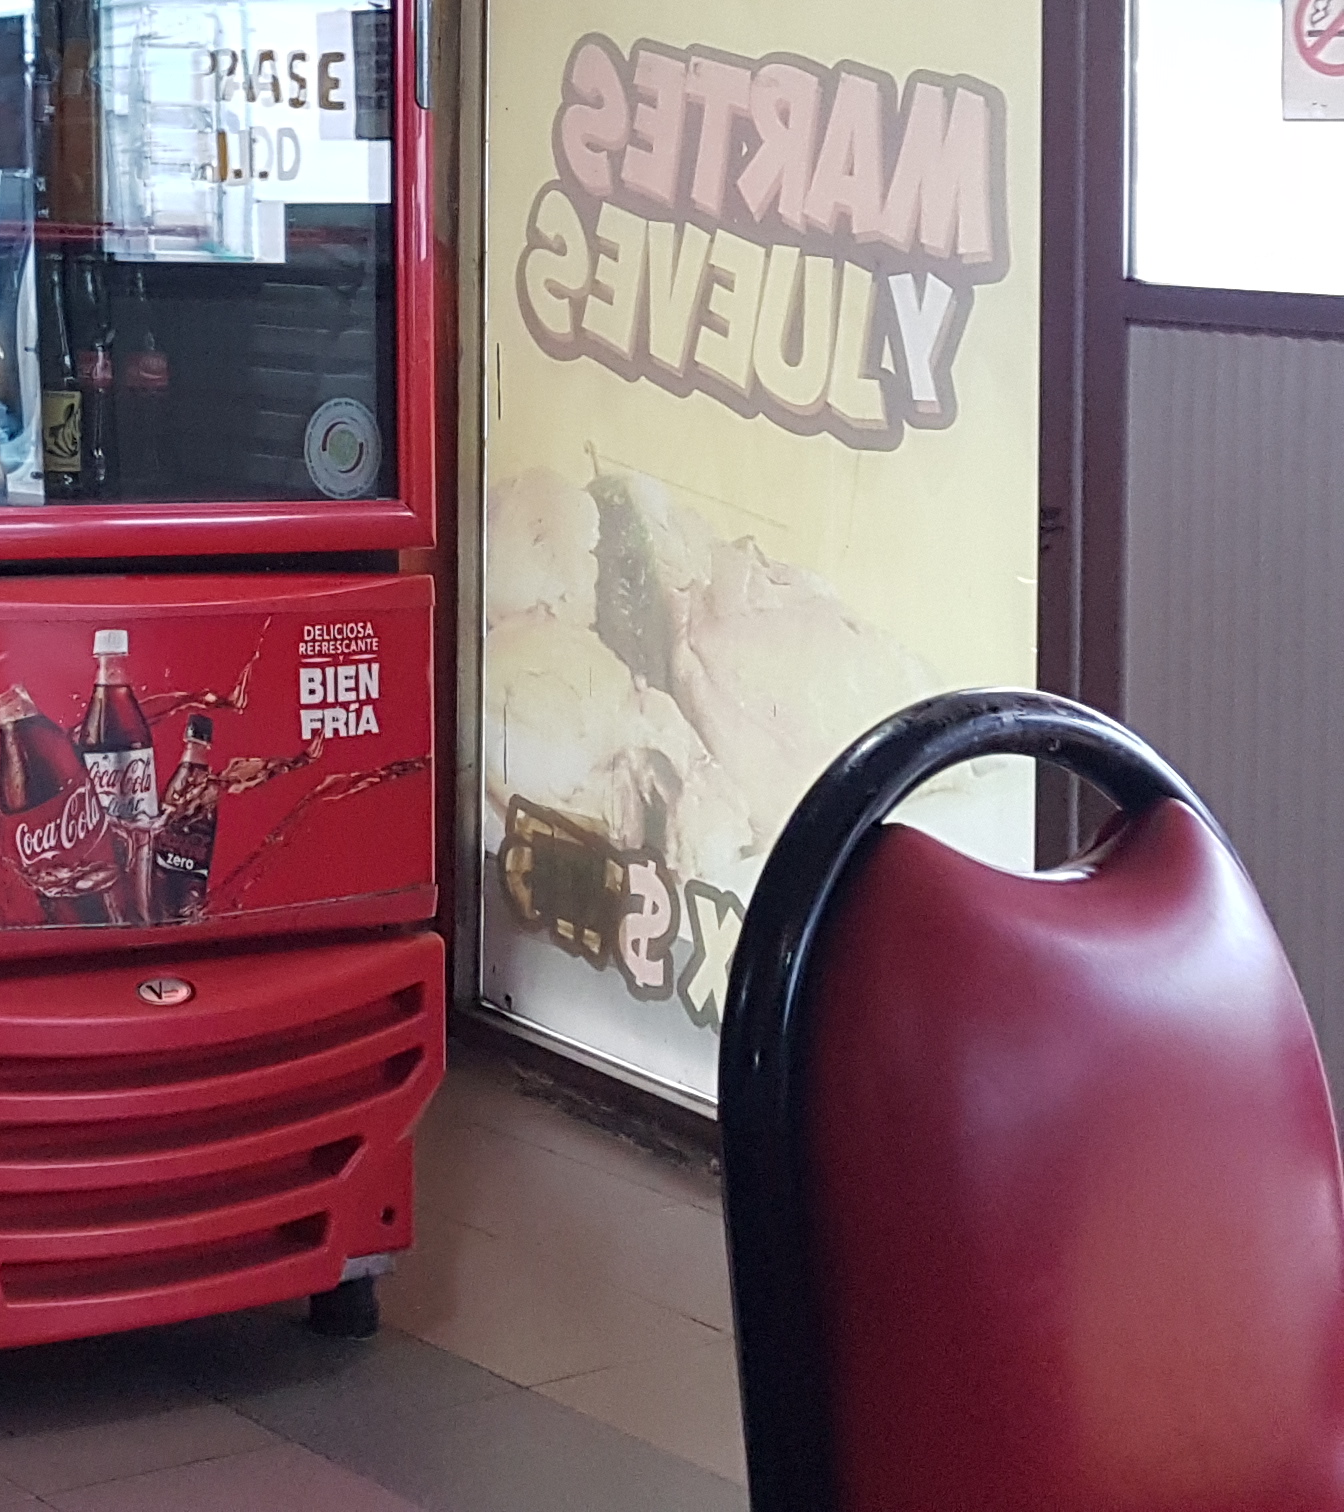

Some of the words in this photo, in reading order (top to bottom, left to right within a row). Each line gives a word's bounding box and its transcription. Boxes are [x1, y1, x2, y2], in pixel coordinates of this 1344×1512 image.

[303, 621, 374, 641] DELICIOSA
[298, 637, 379, 656] REFRESCANTE
[299, 662, 380, 705] BIEN
[15, 784, 102, 866] Coca-Cola
[166, 852, 195, 870] zero
